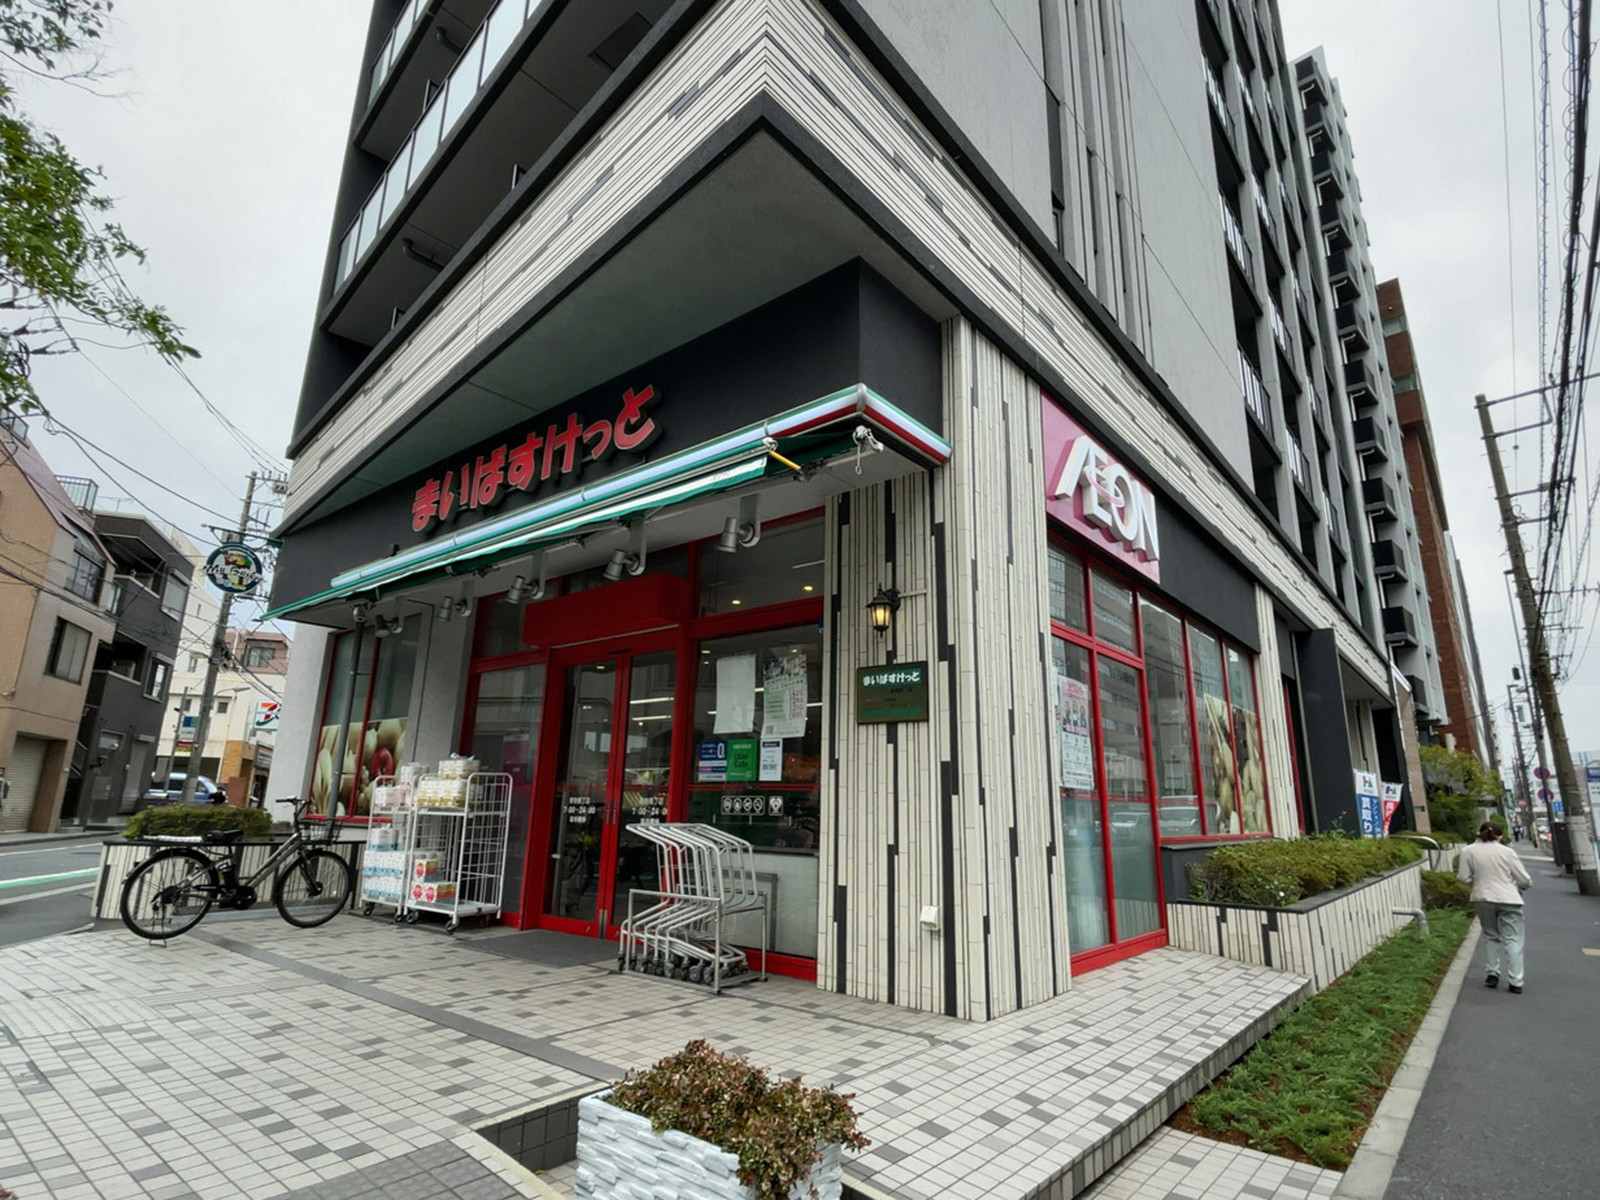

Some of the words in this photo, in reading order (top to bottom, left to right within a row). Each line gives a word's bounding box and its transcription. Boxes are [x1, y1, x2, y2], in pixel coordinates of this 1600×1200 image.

[411, 384, 657, 533] まいばすけっと
[1054, 435, 1160, 562] AEON
[862, 671, 921, 687] まいばすけっと
[1361, 797, 1374, 838] 買取り
